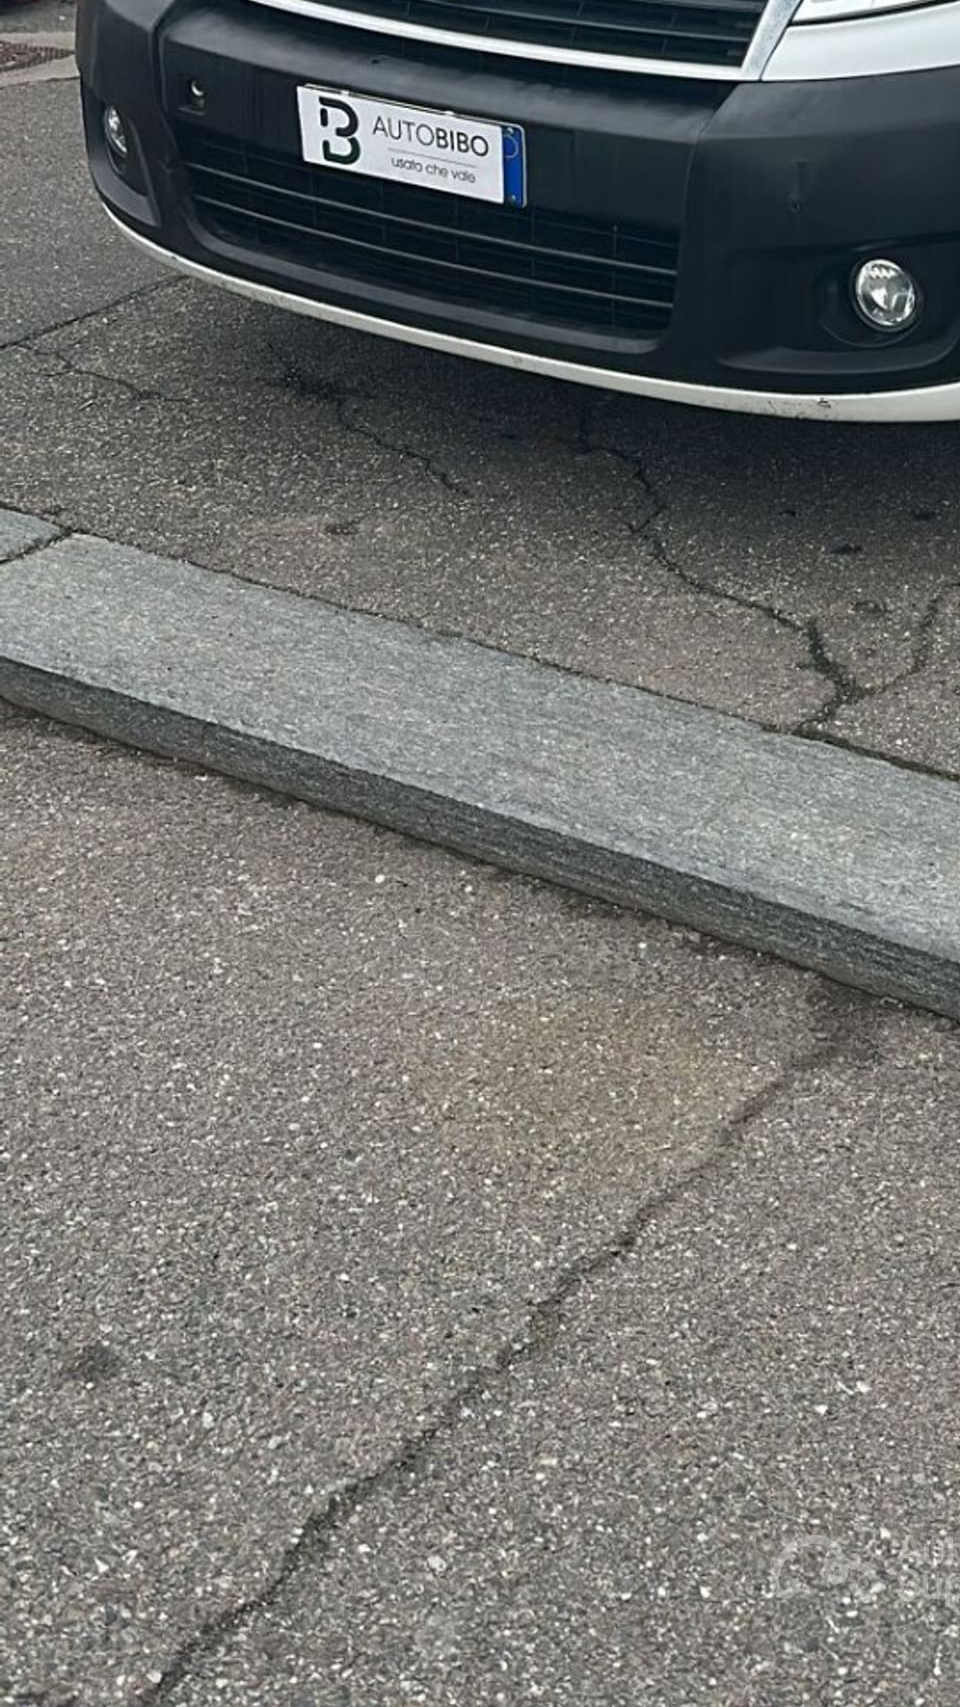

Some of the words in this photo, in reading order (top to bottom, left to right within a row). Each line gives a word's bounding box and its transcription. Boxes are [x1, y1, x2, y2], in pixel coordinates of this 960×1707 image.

[372, 115, 489, 157] AUTOBIBO
[391, 157, 423, 173] usato
[425, 164, 448, 178] che
[451, 170, 476, 183] vale
